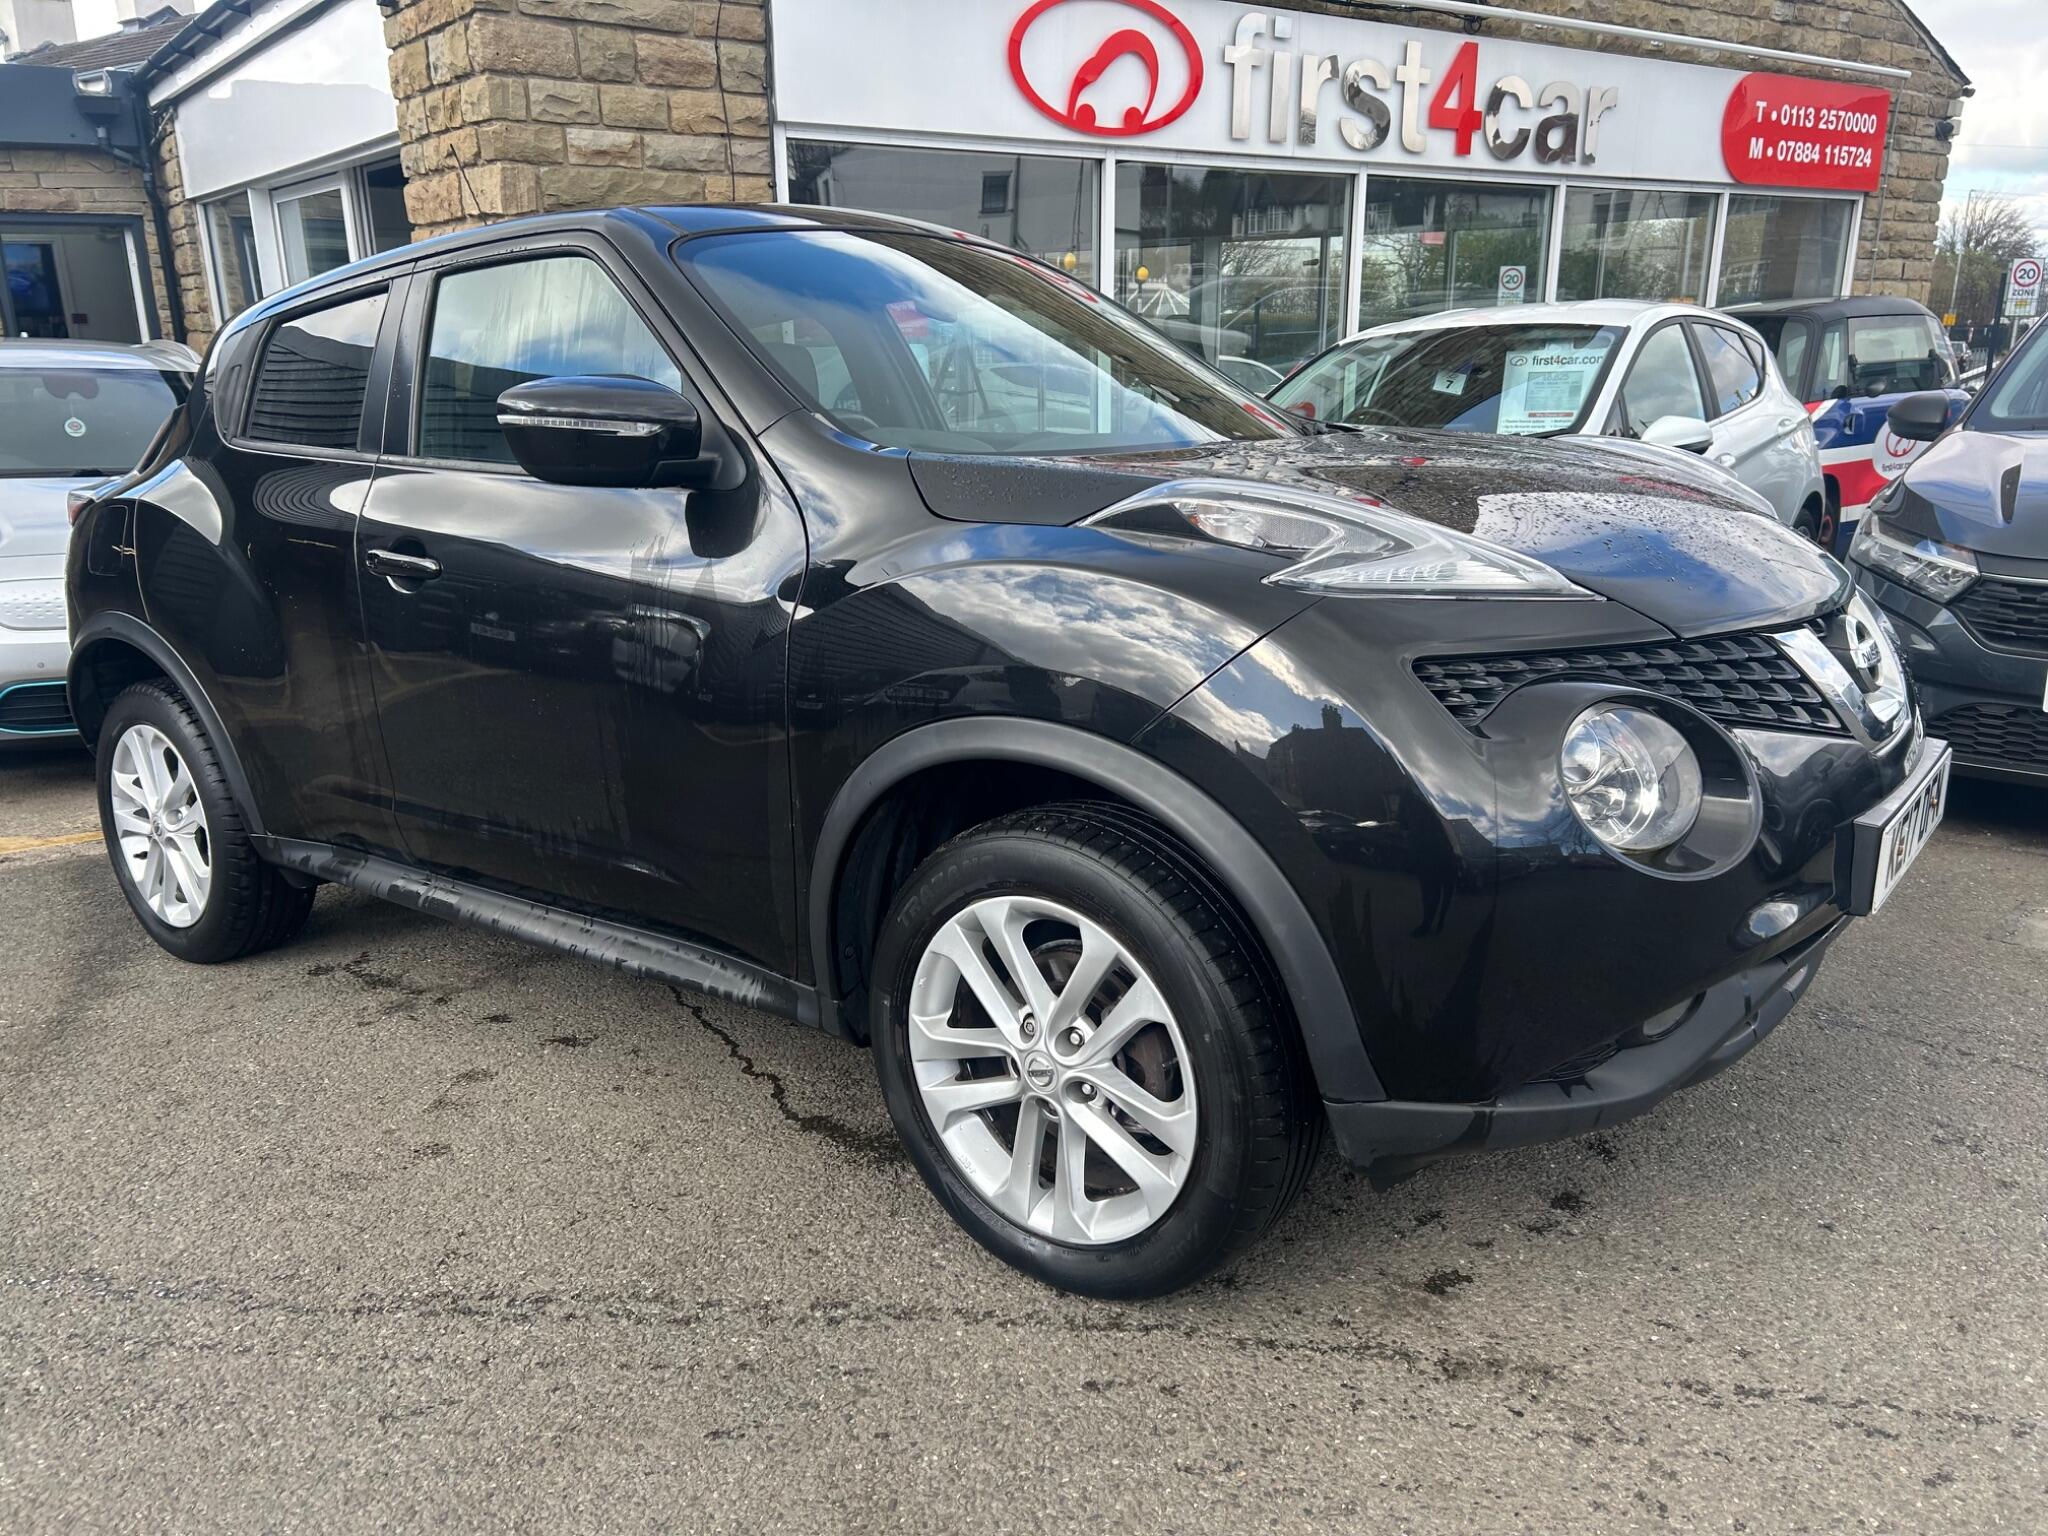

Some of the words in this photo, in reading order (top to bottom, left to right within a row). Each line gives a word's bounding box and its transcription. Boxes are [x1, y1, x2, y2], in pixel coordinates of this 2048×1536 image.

[1224, 12, 1618, 164] first4car
[1756, 100, 1767, 123] T
[1780, 104, 1815, 128] 0113
[1818, 108, 1877, 134] 2570000
[1749, 137, 1764, 160] M
[1776, 140, 1820, 164] 07884
[1825, 145, 1872, 168] 115724
[1504, 274, 1519, 284] 20
[2018, 268, 2036, 280] 20
[2012, 288, 2036, 297] ZONE
[1445, 379, 1454, 389] 7
